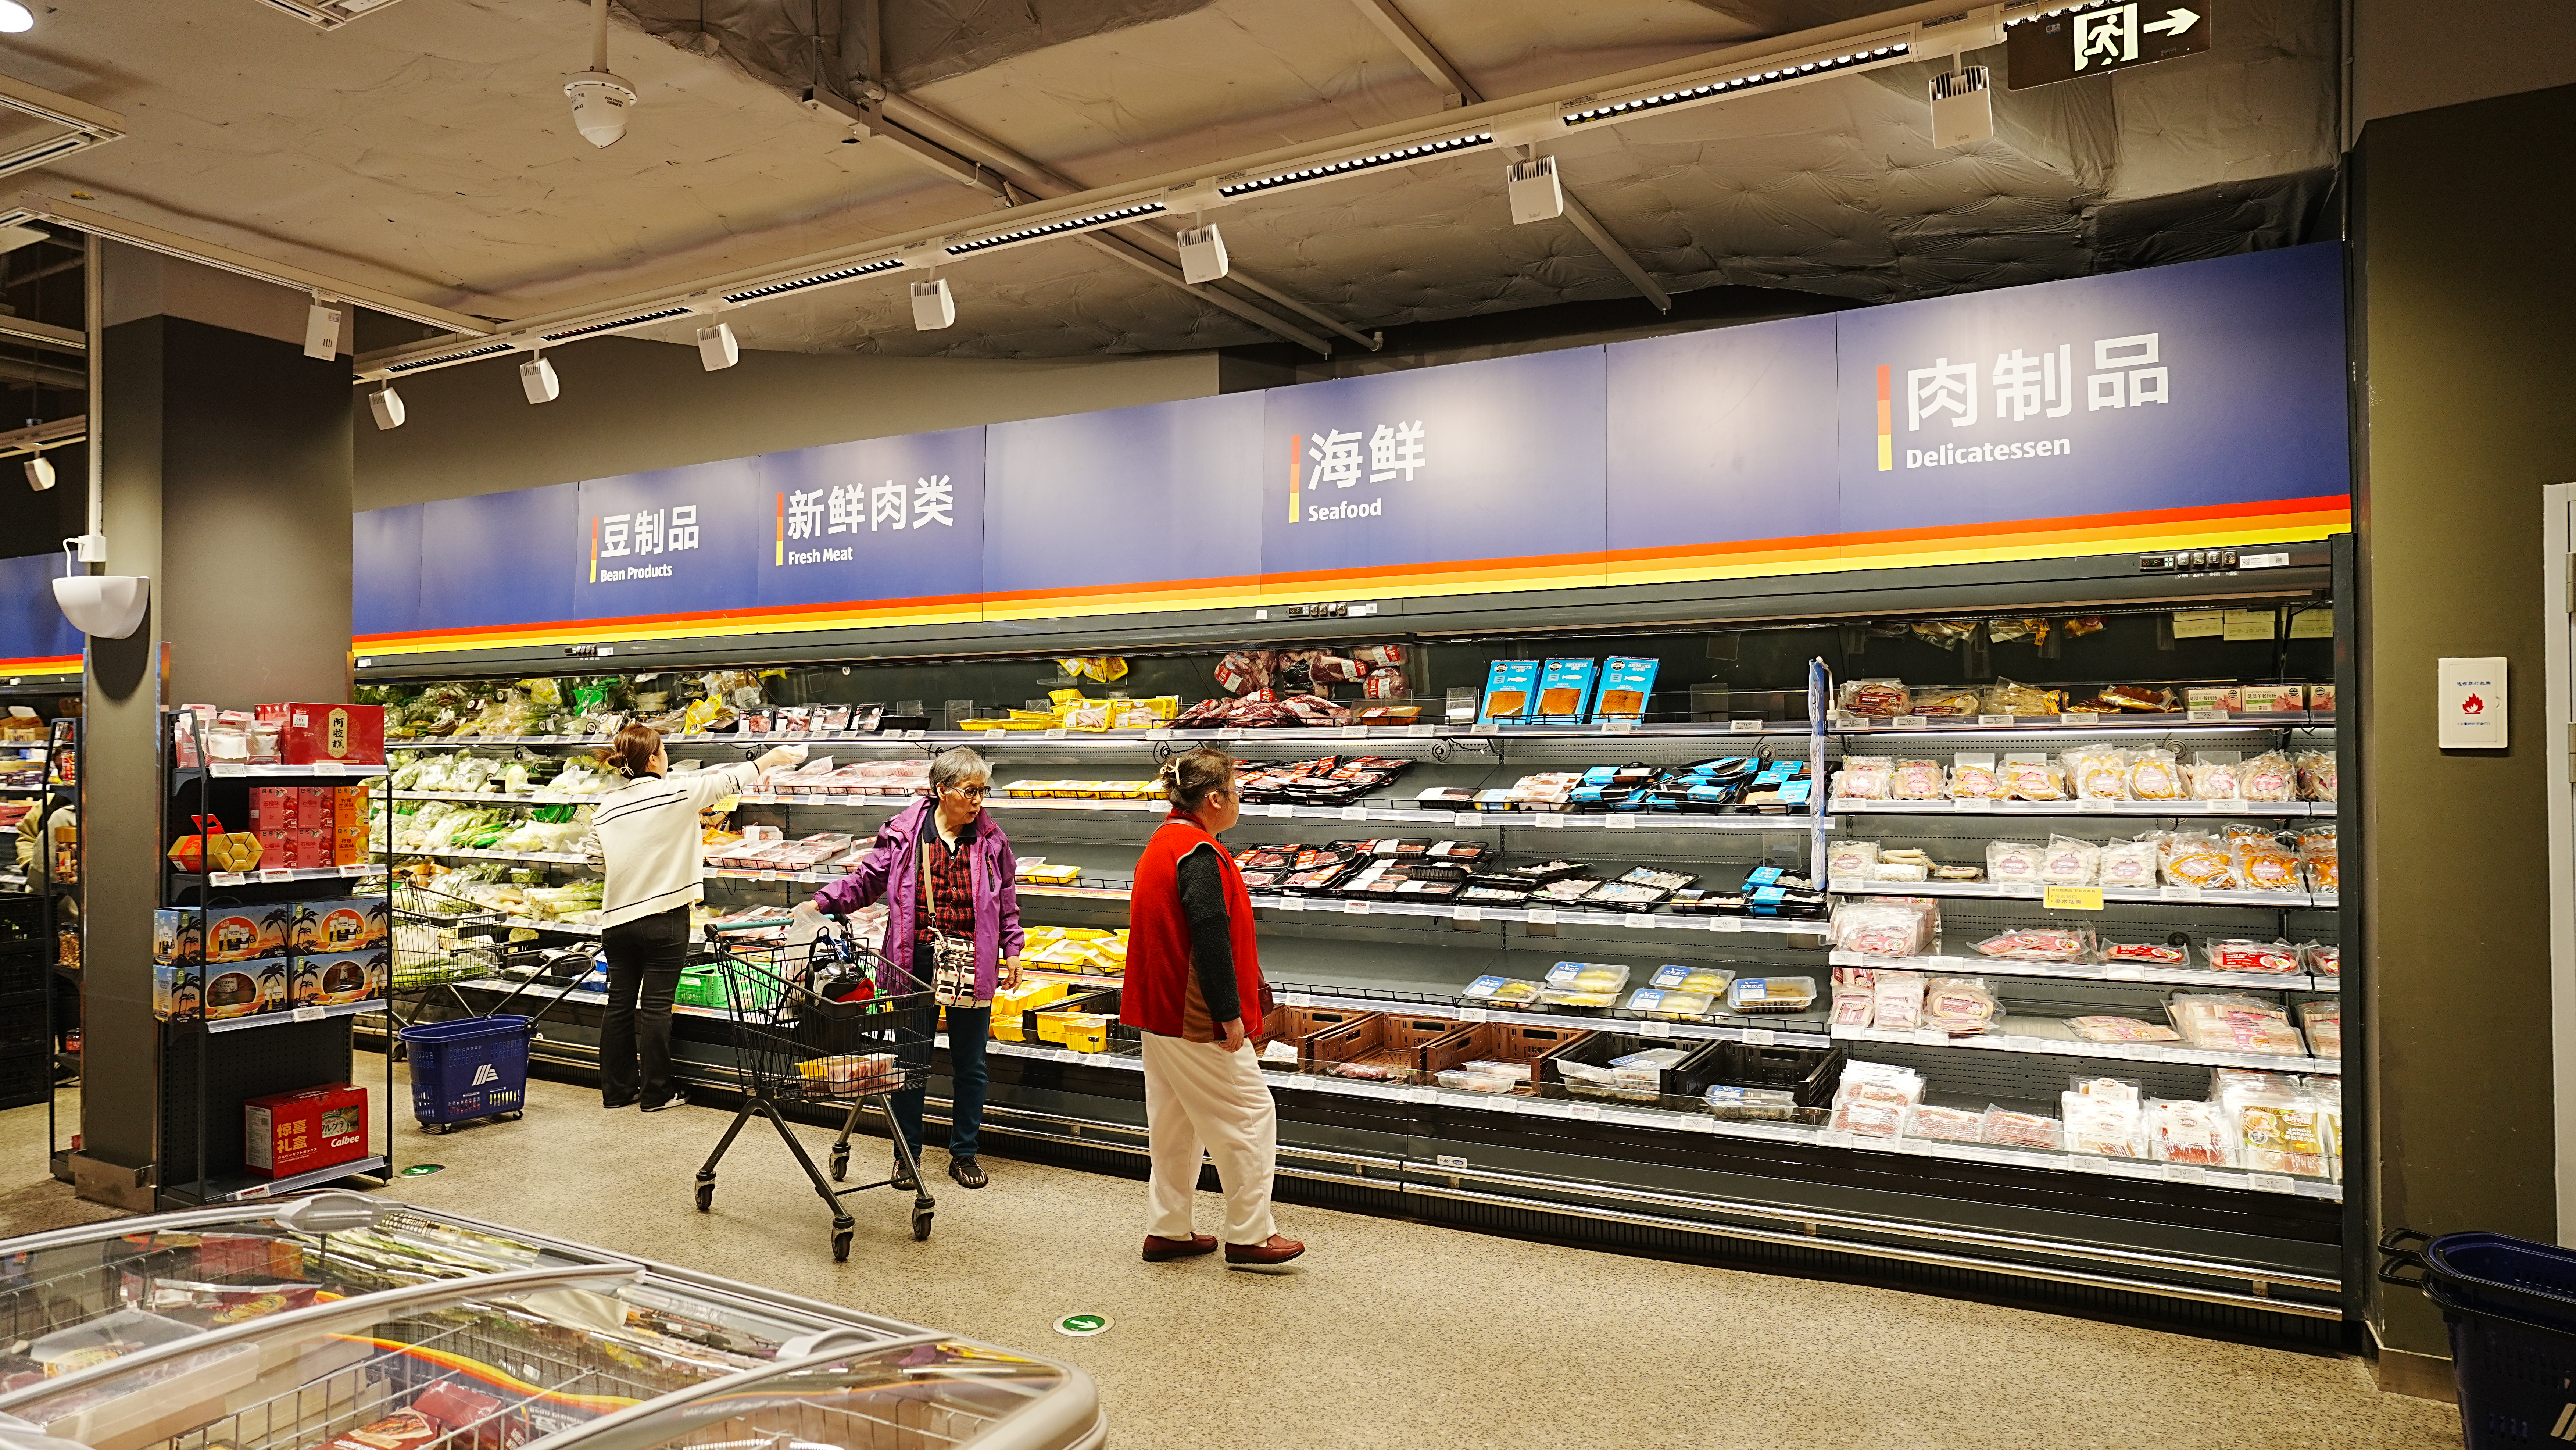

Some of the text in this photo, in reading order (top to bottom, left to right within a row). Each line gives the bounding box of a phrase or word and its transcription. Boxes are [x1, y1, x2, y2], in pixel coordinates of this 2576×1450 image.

[1907, 332, 2169, 431] 肉制品
[1308, 419, 1427, 490] 海鲜
[1907, 436, 2070, 469] Delicatessen
[787, 474, 954, 539] 新鲜肉类
[1308, 498, 1382, 521] Seafood
[601, 505, 699, 558] 豆制品
[788, 546, 853, 565] Fresh Meat
[601, 564, 672, 582] Bean Products
[276, 1119, 307, 1138] 惊喜
[2284, 1115, 2311, 1124] Beretta
[277, 1135, 307, 1153] 礼盒
[330, 1135, 360, 1147] Calbee
